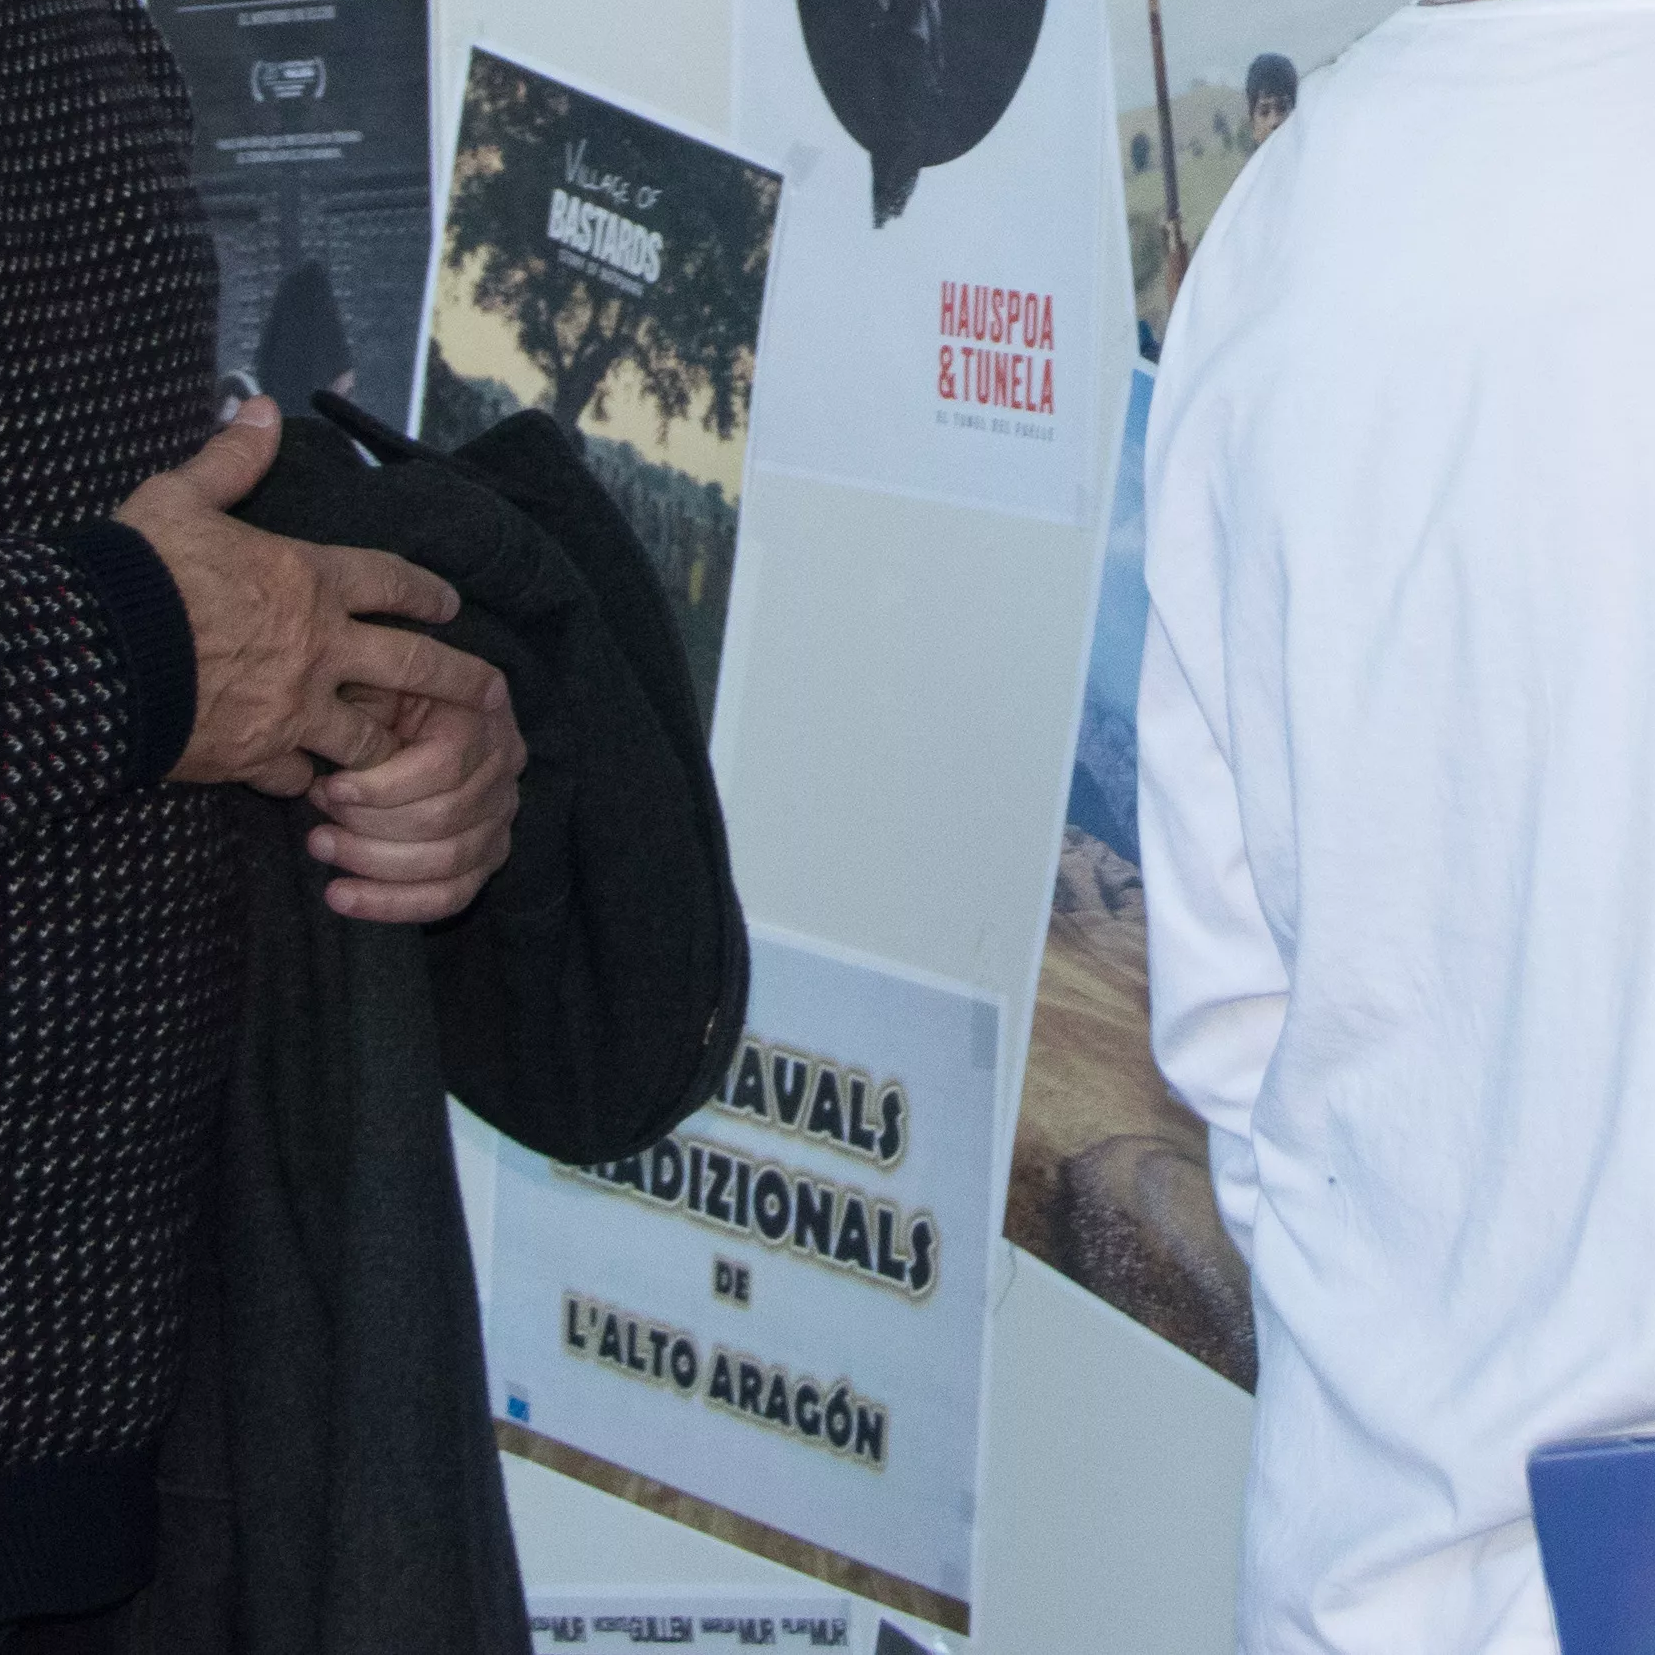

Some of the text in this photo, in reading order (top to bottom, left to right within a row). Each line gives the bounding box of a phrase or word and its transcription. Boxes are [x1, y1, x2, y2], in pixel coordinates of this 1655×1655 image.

[547, 188, 664, 284] BASTARDS
[940, 281, 1055, 351] HAUSPOA
[713, 1258, 751, 1304] DE
[566, 1299, 886, 1464] L'ALTO ARAGÓN
